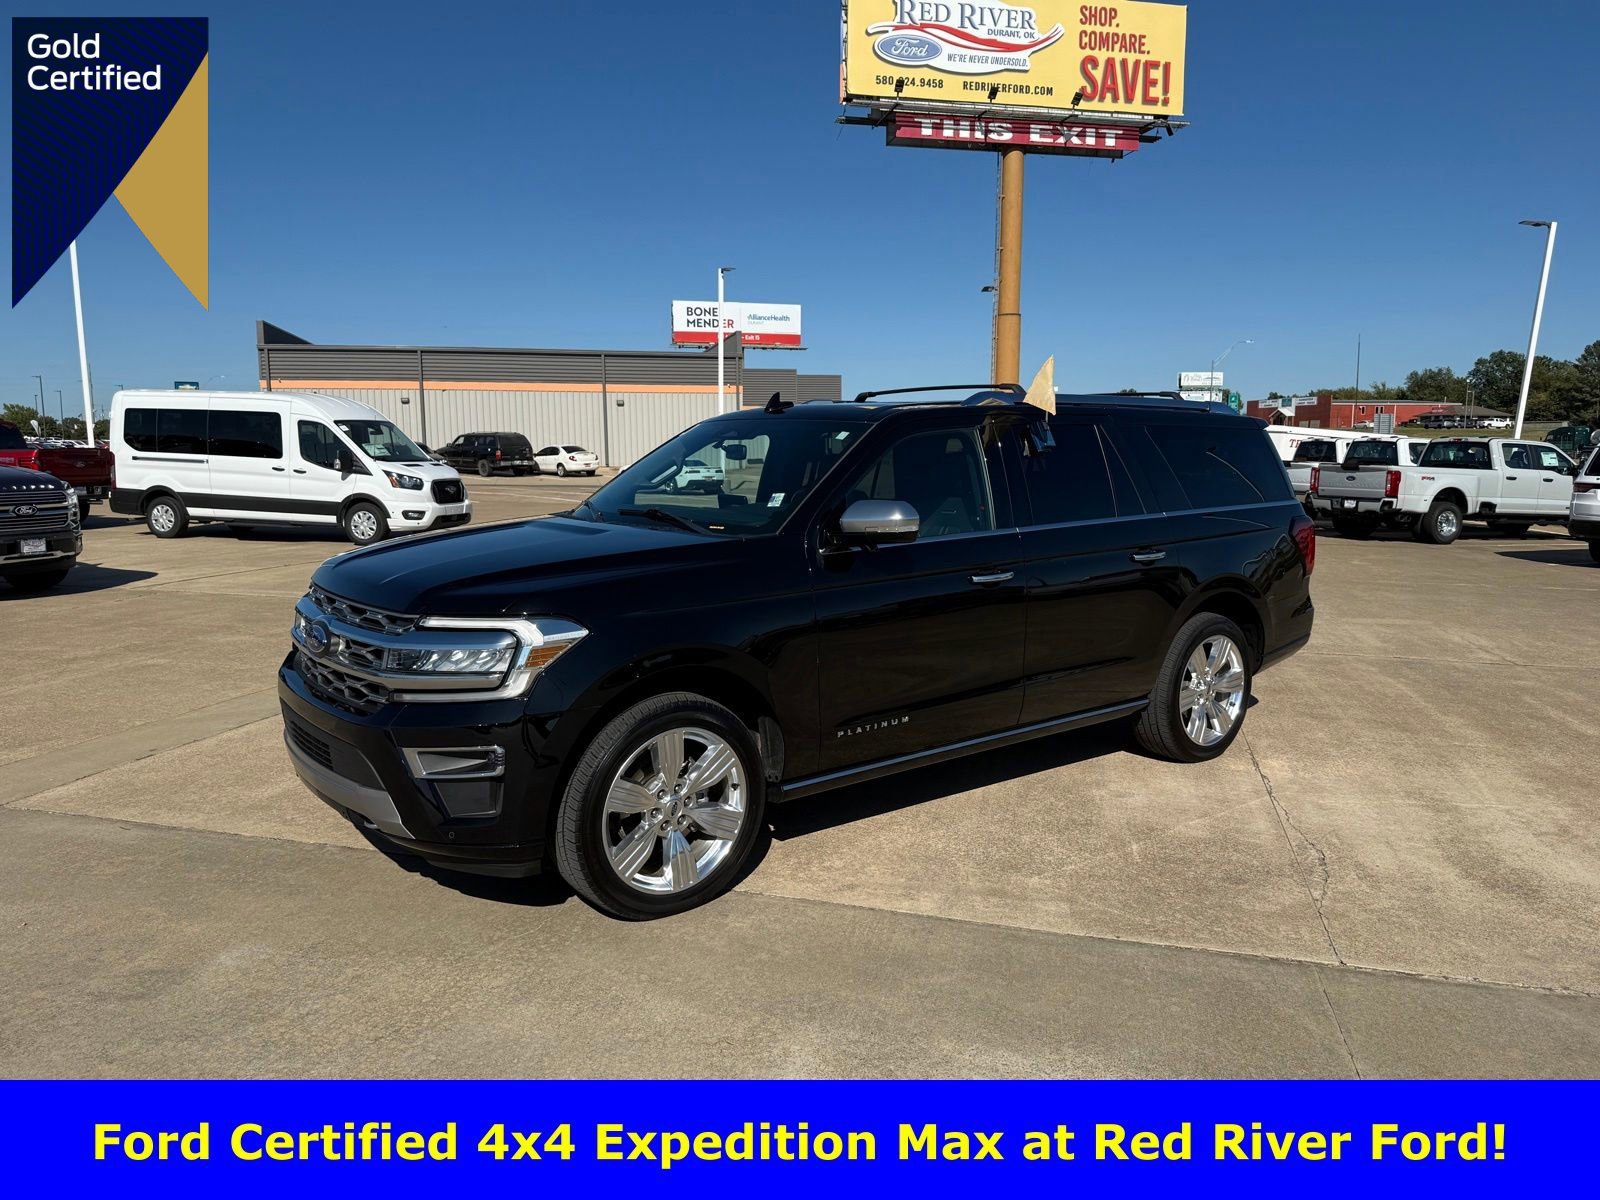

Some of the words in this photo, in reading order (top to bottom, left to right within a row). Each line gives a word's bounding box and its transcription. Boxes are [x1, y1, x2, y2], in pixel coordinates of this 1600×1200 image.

[896, 0, 951, 25] RED
[957, 2, 1035, 30] RIVER
[1079, 5, 1120, 28] SHOP.
[987, 28, 1021, 39] DURANT,
[1023, 31, 1035, 39] OK
[1078, 29, 1150, 55] COMPARE.
[891, 37, 929, 57] Ford
[947, 53, 967, 63] WE'RE
[968, 55, 989, 65] NEVER
[990, 56, 1028, 67] UNDERSOLD.
[1080, 54, 1171, 106] SAVE!
[914, 118, 1014, 141] THIS
[1029, 124, 1123, 147] EXIT
[686, 306, 718, 317] BONE
[747, 313, 790, 322] AllianceHealth
[837, 716, 909, 738] PLATINUM
